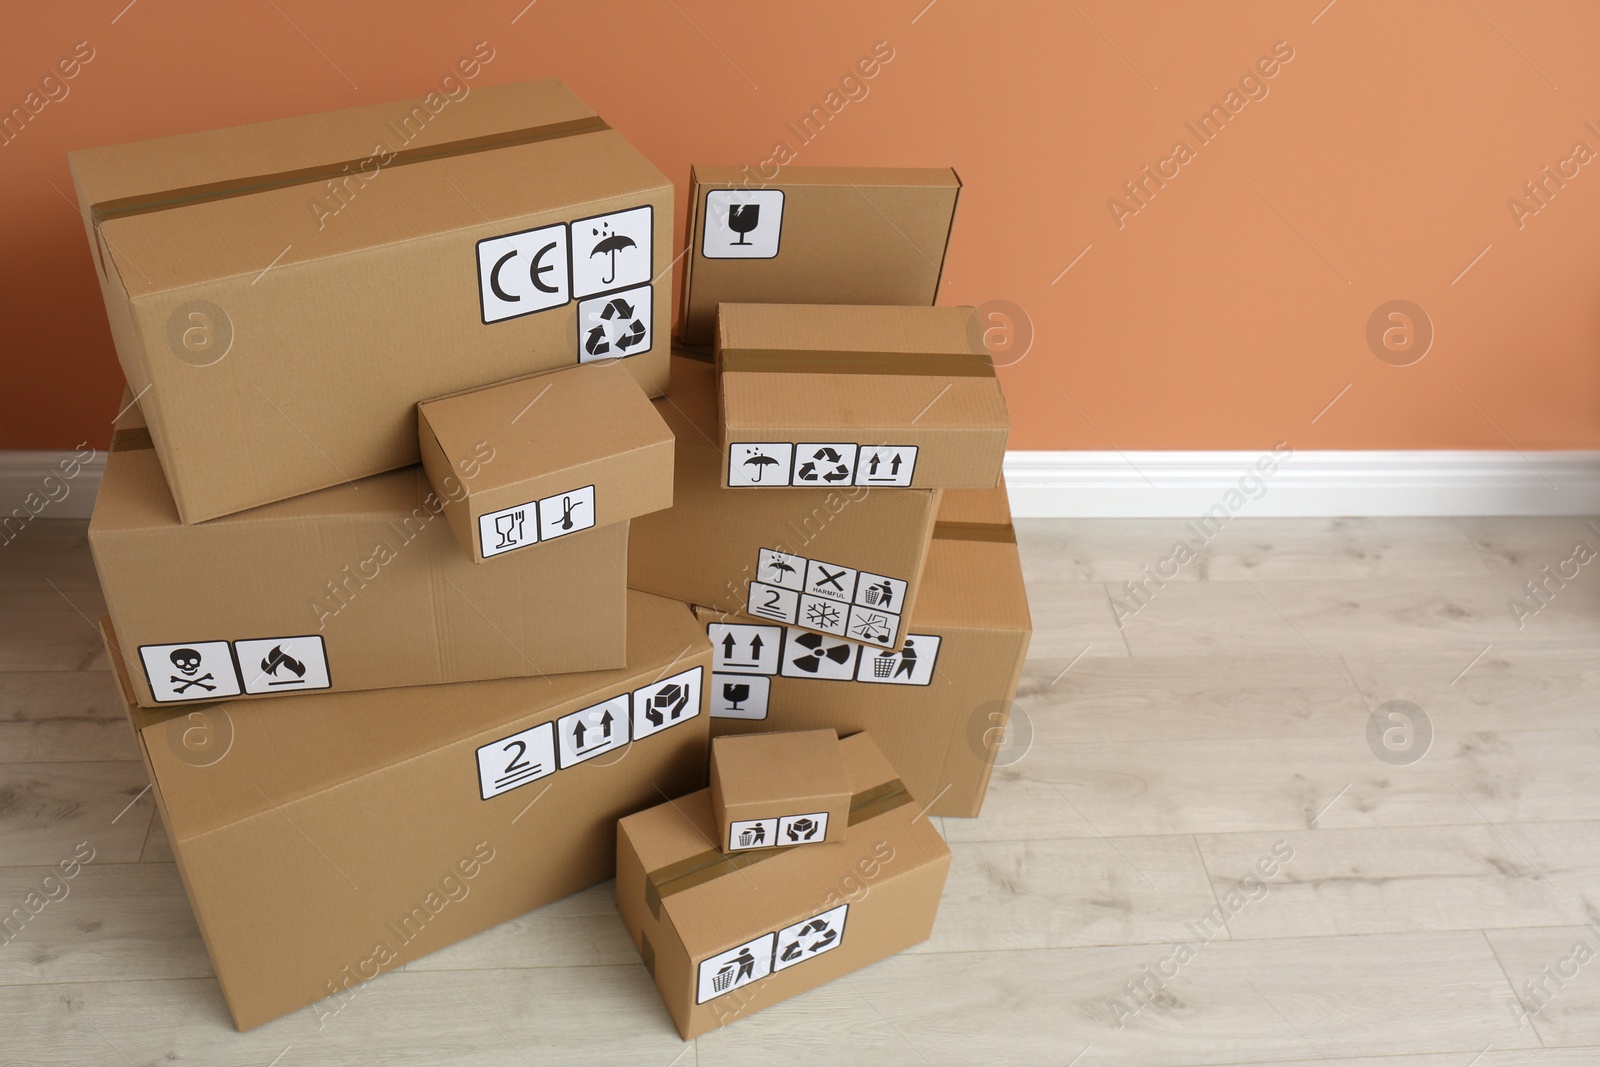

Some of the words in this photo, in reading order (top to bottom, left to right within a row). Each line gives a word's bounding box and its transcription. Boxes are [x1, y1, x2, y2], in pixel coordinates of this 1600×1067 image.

[490, 241, 559, 302] CE
[763, 590, 781, 611] 2
[813, 587, 845, 599] HARMFUL
[502, 740, 530, 774] 2
